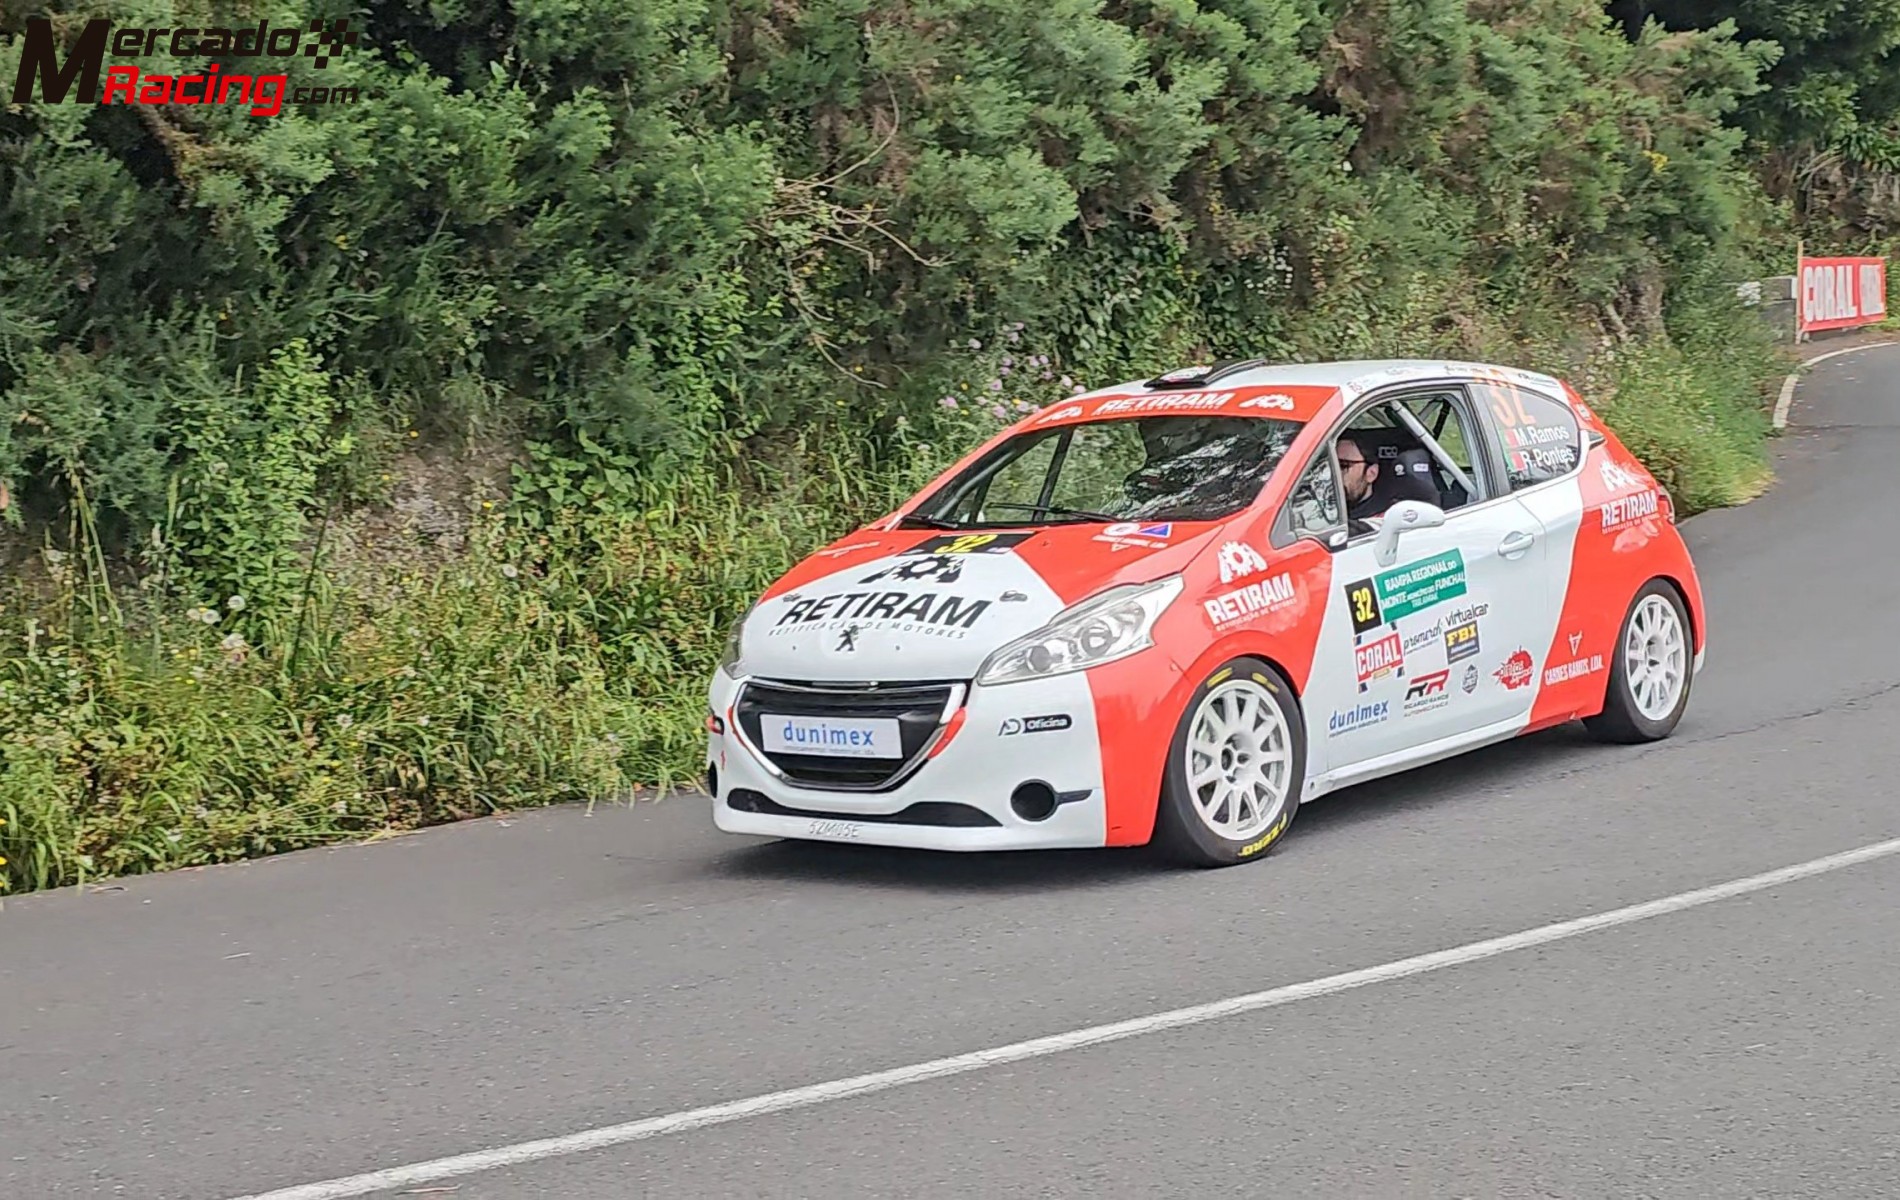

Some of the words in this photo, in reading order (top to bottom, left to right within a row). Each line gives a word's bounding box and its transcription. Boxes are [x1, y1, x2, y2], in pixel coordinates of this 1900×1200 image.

[1803, 265, 1853, 322] CORAL
[1098, 392, 1236, 412] RETIRAM
[1600, 489, 1658, 527] RETIRAM
[934, 534, 998, 555] 32
[1380, 591, 1408, 608] MONTE
[1435, 571, 1465, 590] FUNCHAL
[1384, 573, 1412, 592] RAMPA
[1411, 560, 1449, 581] REGIONAL
[776, 591, 992, 629] RETIRAM
[1203, 572, 1296, 625] RETIRAM
[1352, 587, 1375, 622] 32
[863, 621, 882, 630] DE
[891, 622, 966, 640] MOTORES
[1446, 623, 1477, 647] FBI
[1357, 637, 1401, 676] CORAL
[1329, 700, 1389, 731] dunimex
[783, 720, 874, 745] dunimex
